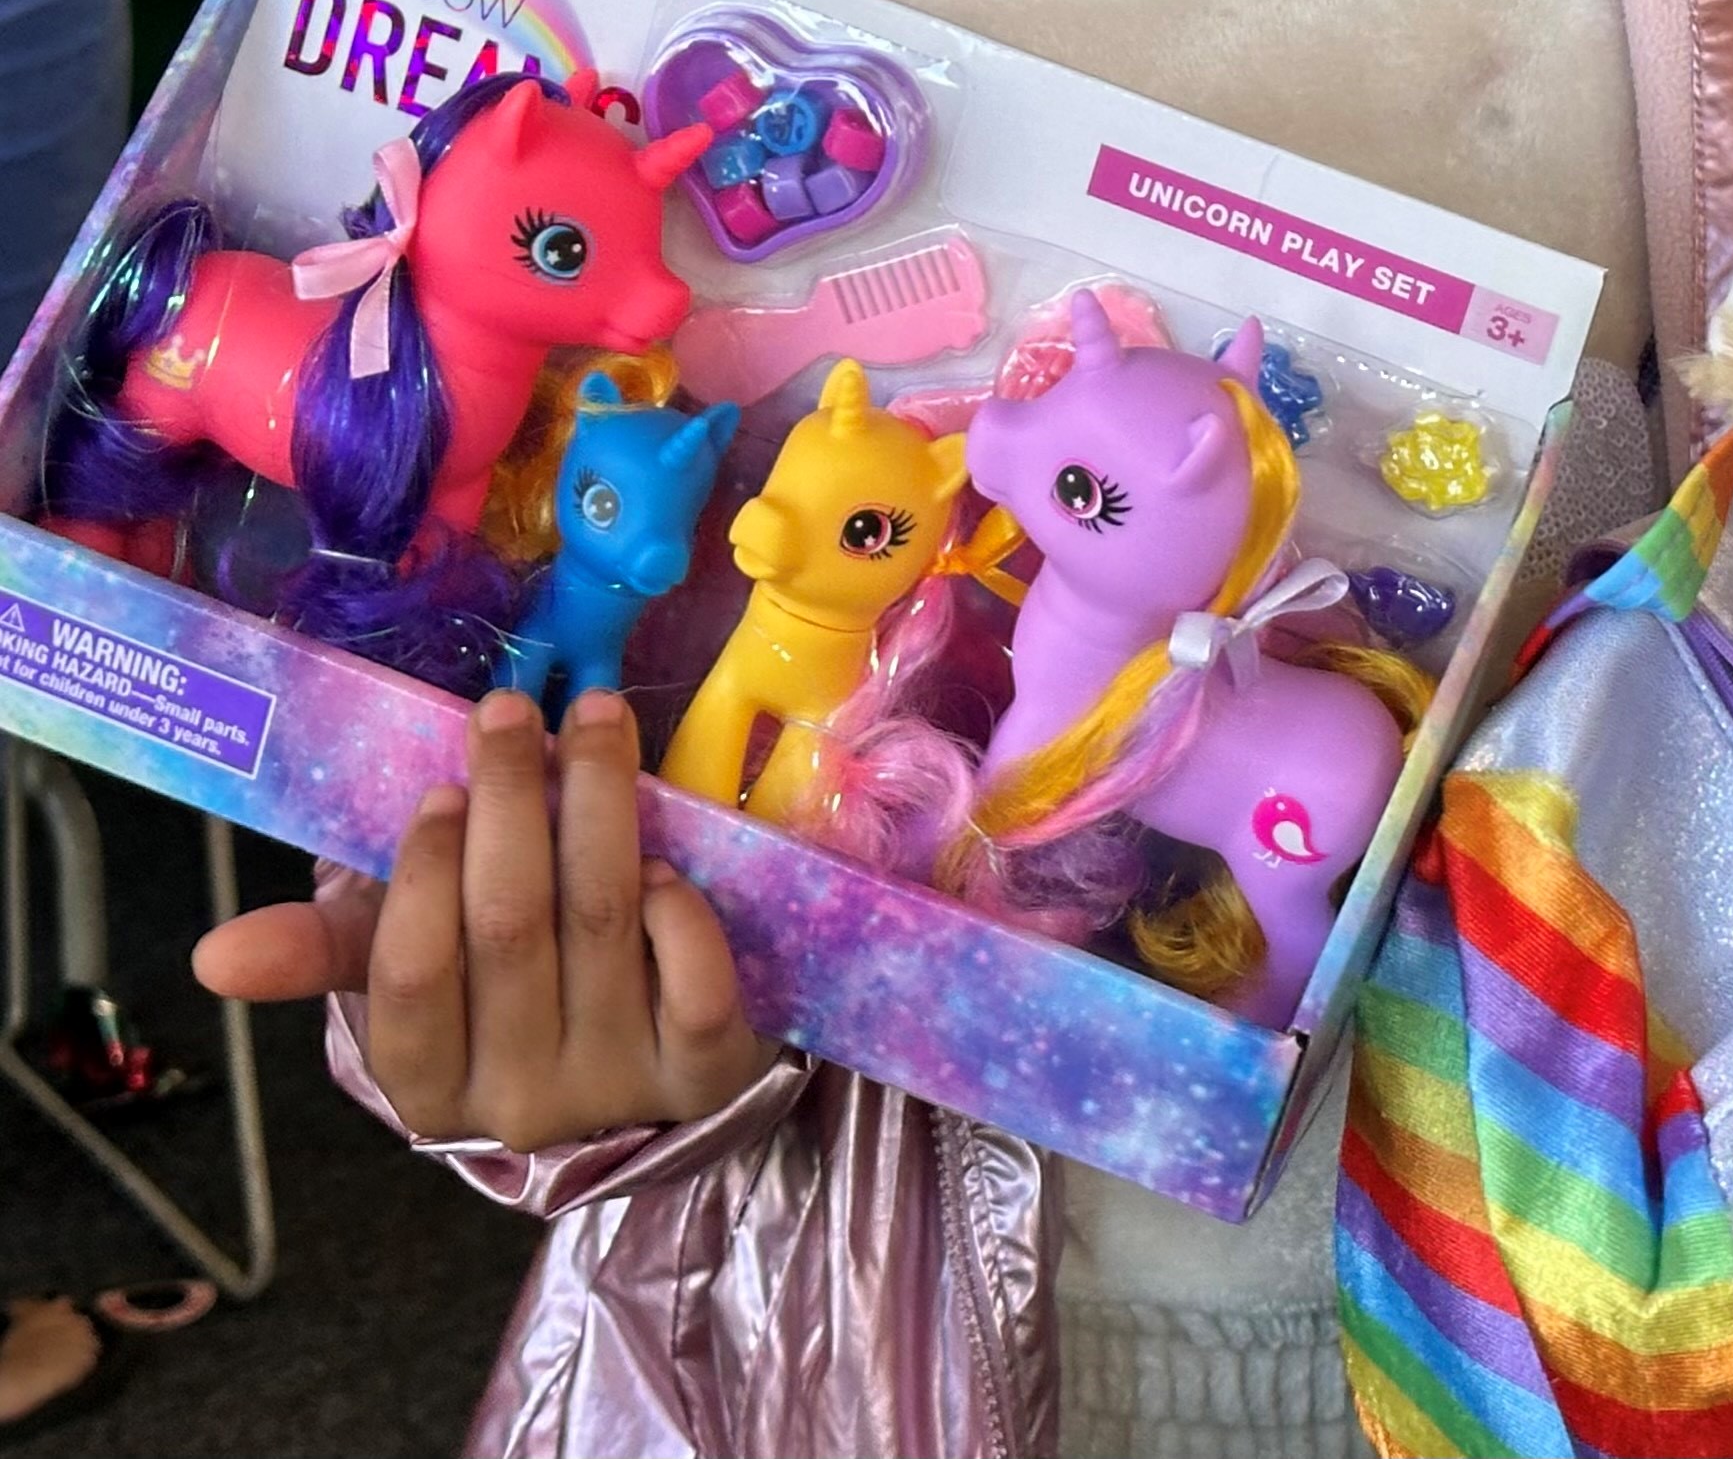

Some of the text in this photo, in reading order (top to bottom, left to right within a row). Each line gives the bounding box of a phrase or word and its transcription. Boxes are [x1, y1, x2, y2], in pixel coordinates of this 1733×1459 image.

[1128, 172, 1436, 306] UNICORN PLAY SET
[1487, 316, 1526, 347] 3+
[1494, 304, 1532, 324] AGES
[0, 628, 49, 665] KING
[203, 716, 249, 746] parts.
[52, 619, 187, 695] WARNING:
[12, 658, 39, 680] for
[39, 668, 105, 709] children
[108, 700, 156, 728] under
[158, 717, 171, 735] 3
[174, 725, 221, 755] years.
